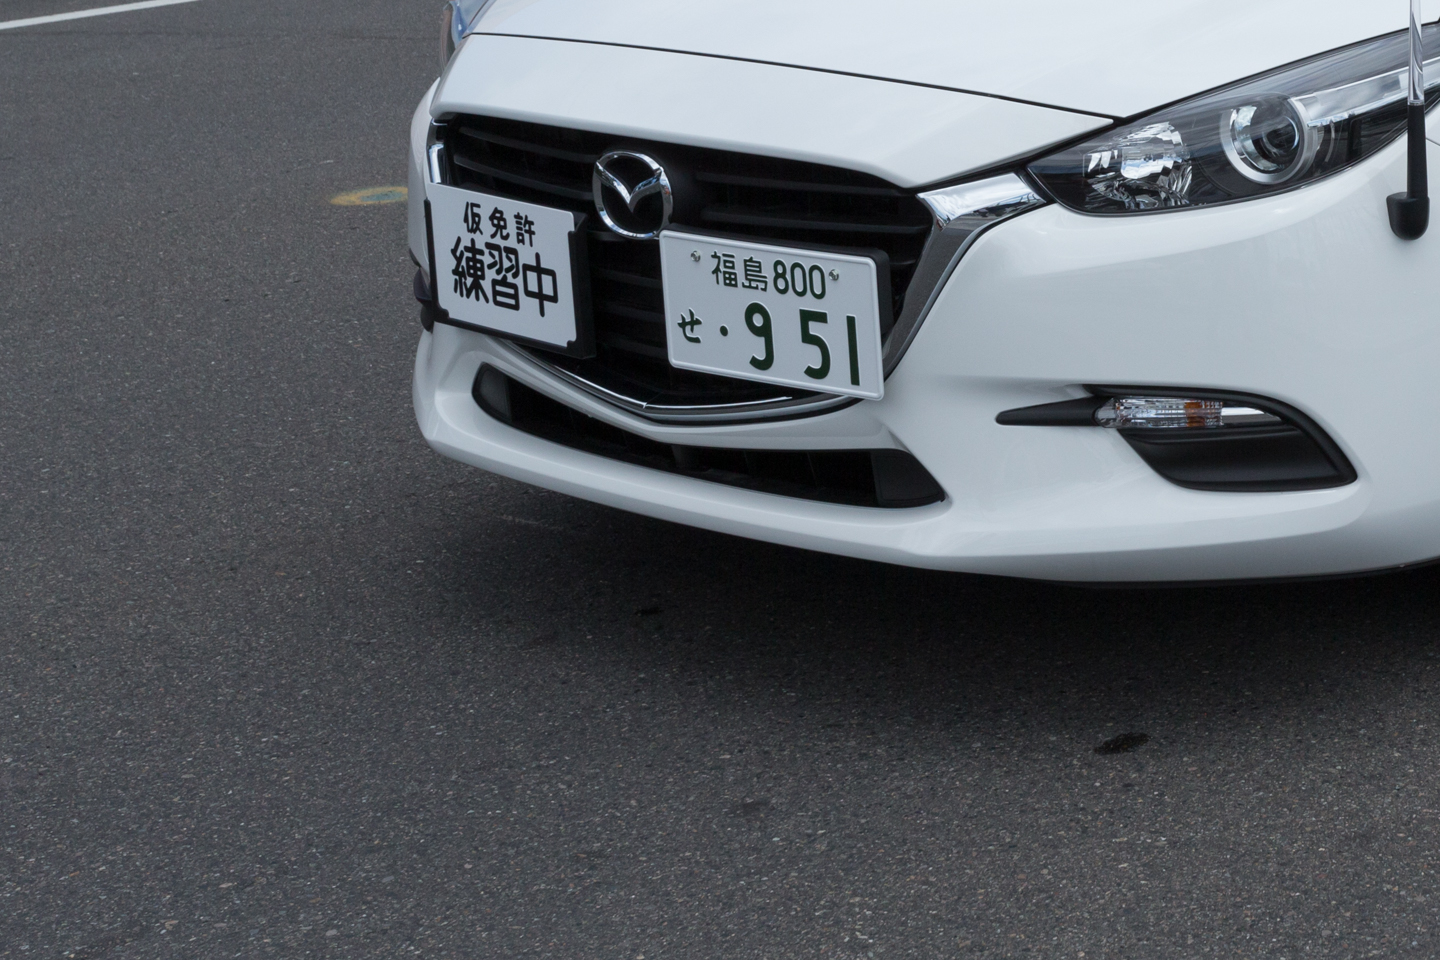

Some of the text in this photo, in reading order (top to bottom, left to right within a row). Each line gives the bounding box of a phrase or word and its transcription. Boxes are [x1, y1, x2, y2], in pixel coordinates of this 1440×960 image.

[463, 201, 536, 248] 仮免許
[451, 235, 558, 318] 練習中
